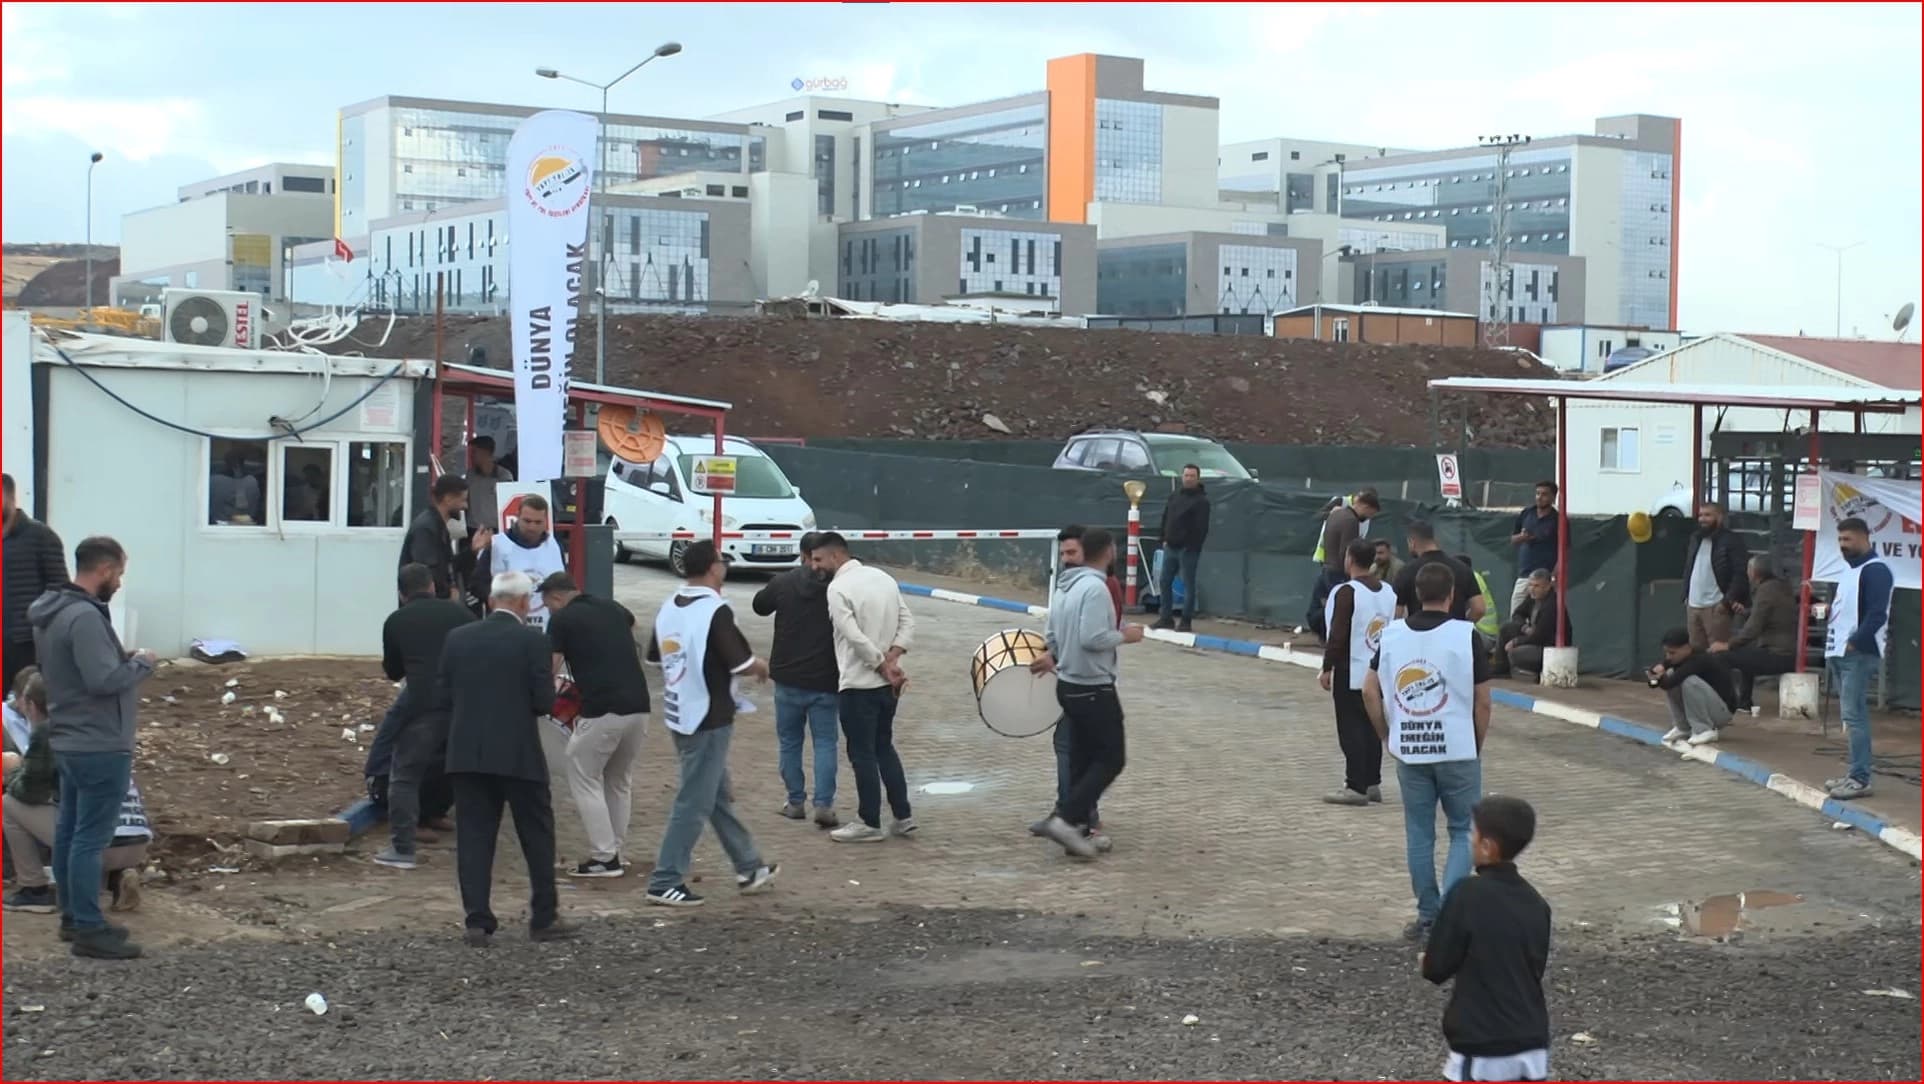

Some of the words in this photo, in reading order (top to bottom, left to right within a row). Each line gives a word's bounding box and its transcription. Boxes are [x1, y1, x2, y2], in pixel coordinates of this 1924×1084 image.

[523, 304, 552, 390] DÜNYA
[1882, 541, 1903, 558] VE
[1400, 720, 1442, 731] DÜNYA
[1400, 745, 1447, 755] OLACAK
